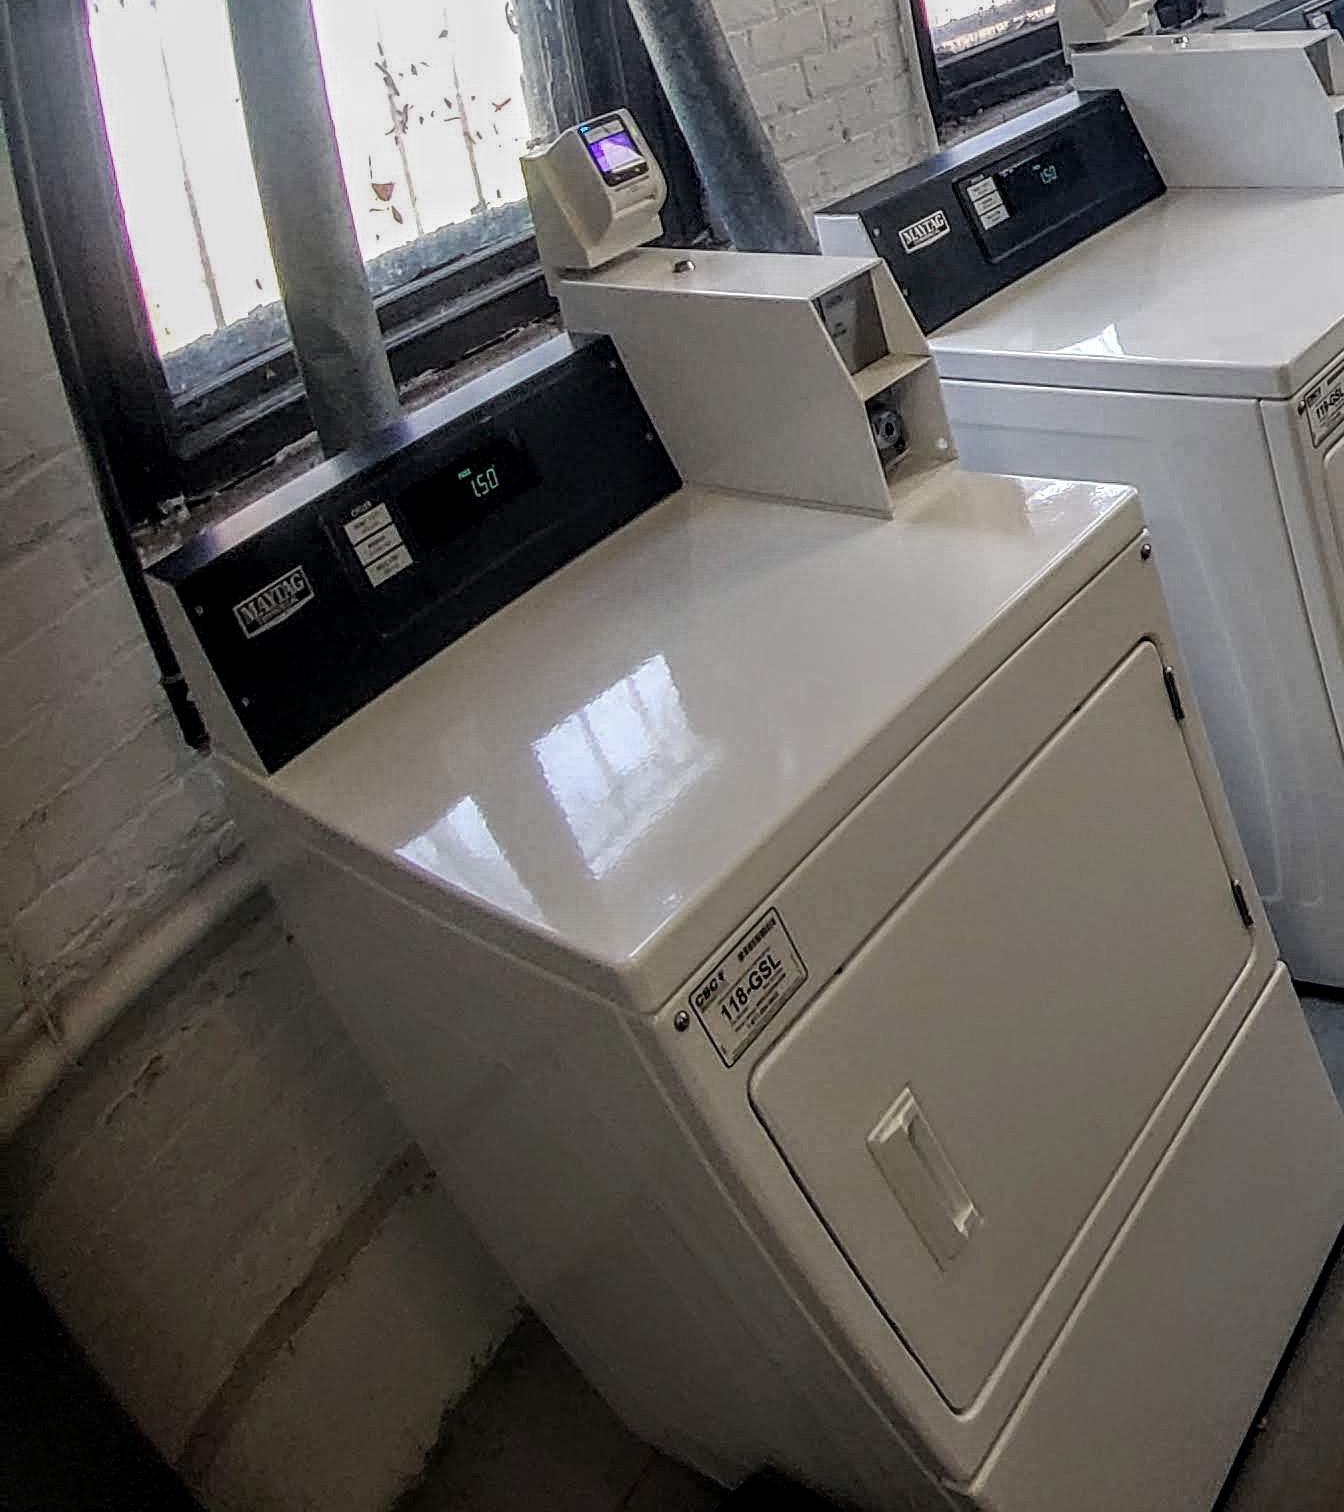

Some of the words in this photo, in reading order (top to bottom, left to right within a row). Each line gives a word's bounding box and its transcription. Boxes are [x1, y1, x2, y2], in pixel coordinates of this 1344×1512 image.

[903, 214, 945, 245] MAYTAG
[239, 572, 305, 625] MAYTAG
[720, 953, 782, 1021] 118-GSL
